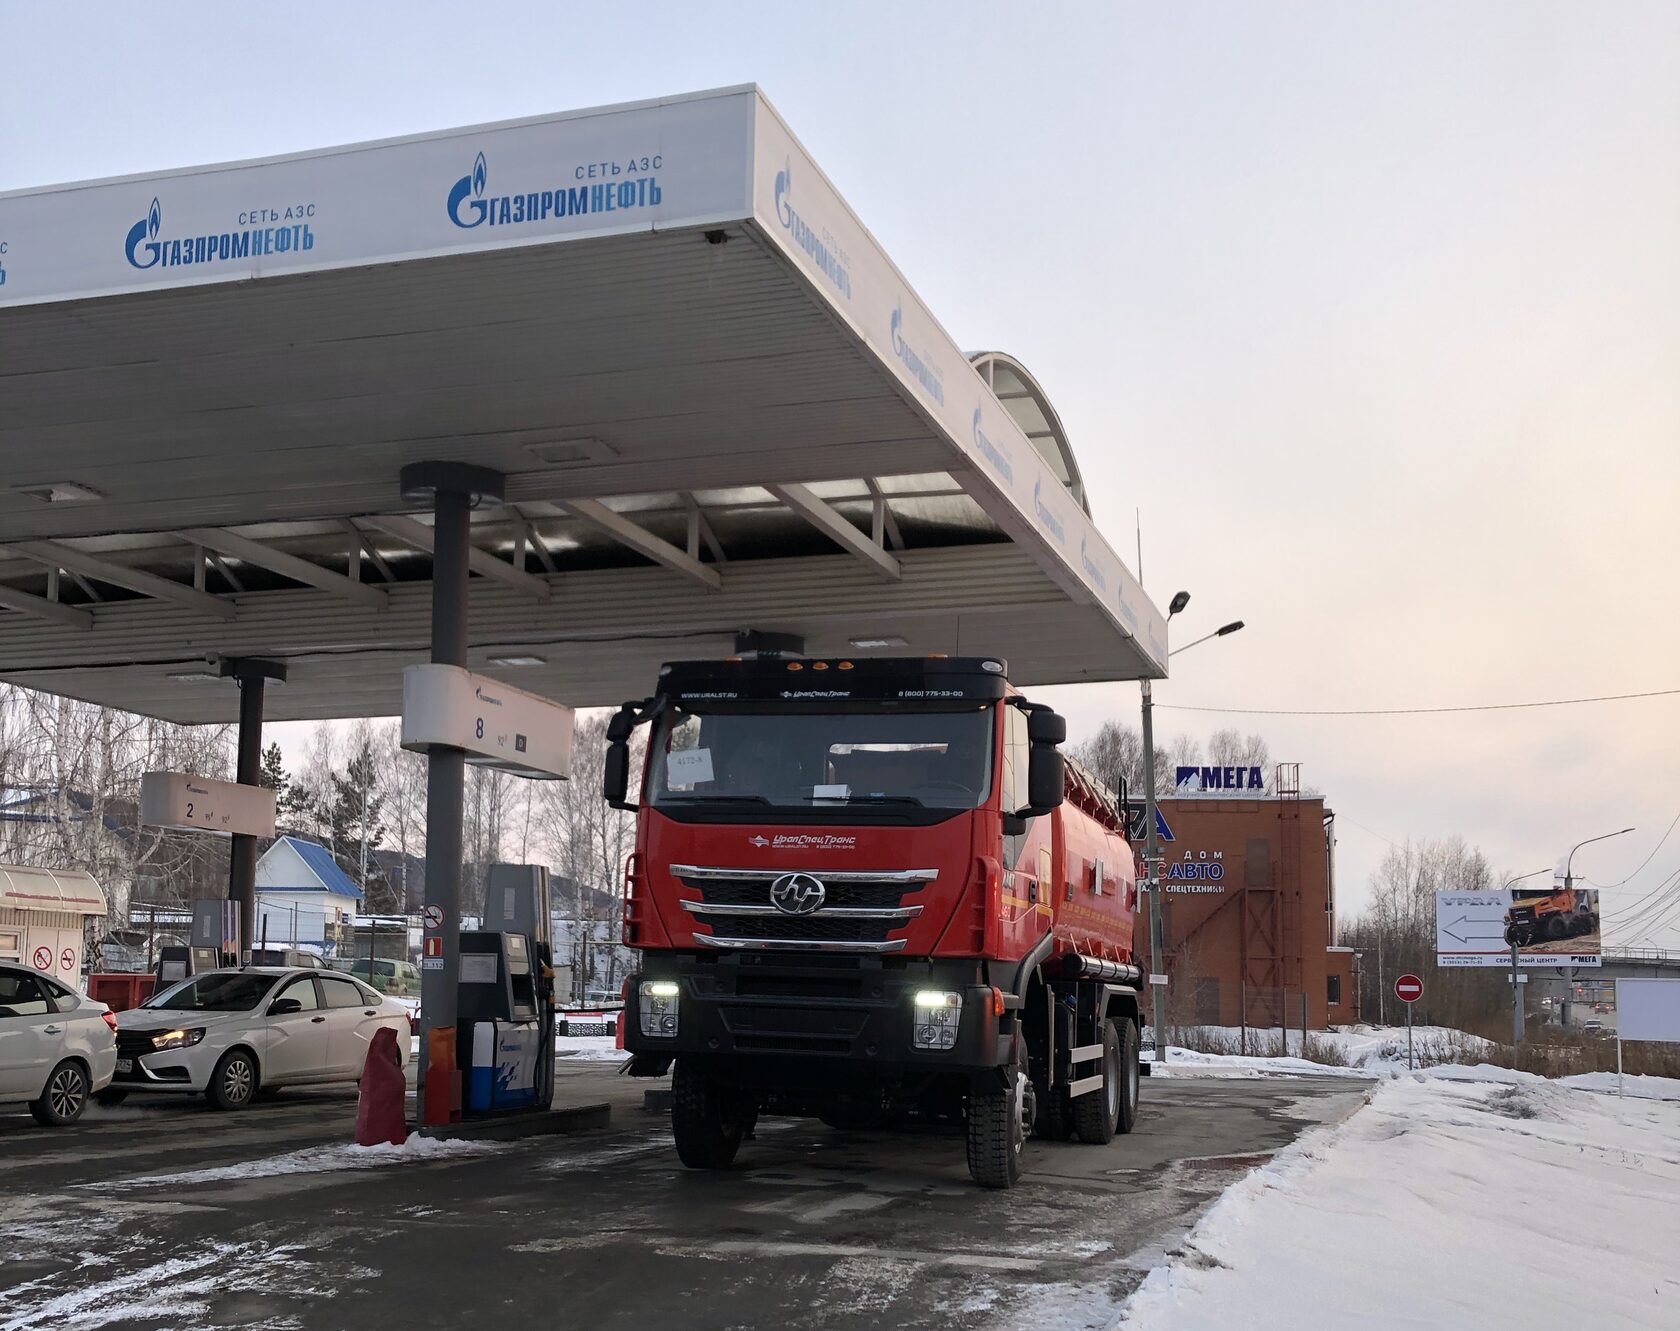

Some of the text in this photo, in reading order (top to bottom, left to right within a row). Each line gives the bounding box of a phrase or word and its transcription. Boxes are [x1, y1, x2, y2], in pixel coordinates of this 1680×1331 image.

[575, 156, 663, 180] СЕТЬ АЗС
[489, 176, 662, 226] ГАЗПРОМНЕФТЬ
[238, 204, 315, 225] СЕТЬ АЗС
[162, 224, 314, 267] ГАЗПРОМНЕФТЬ
[476, 717, 484, 739] 8
[1201, 766, 1264, 788] МЕГА
[186, 803, 194, 818] 2
